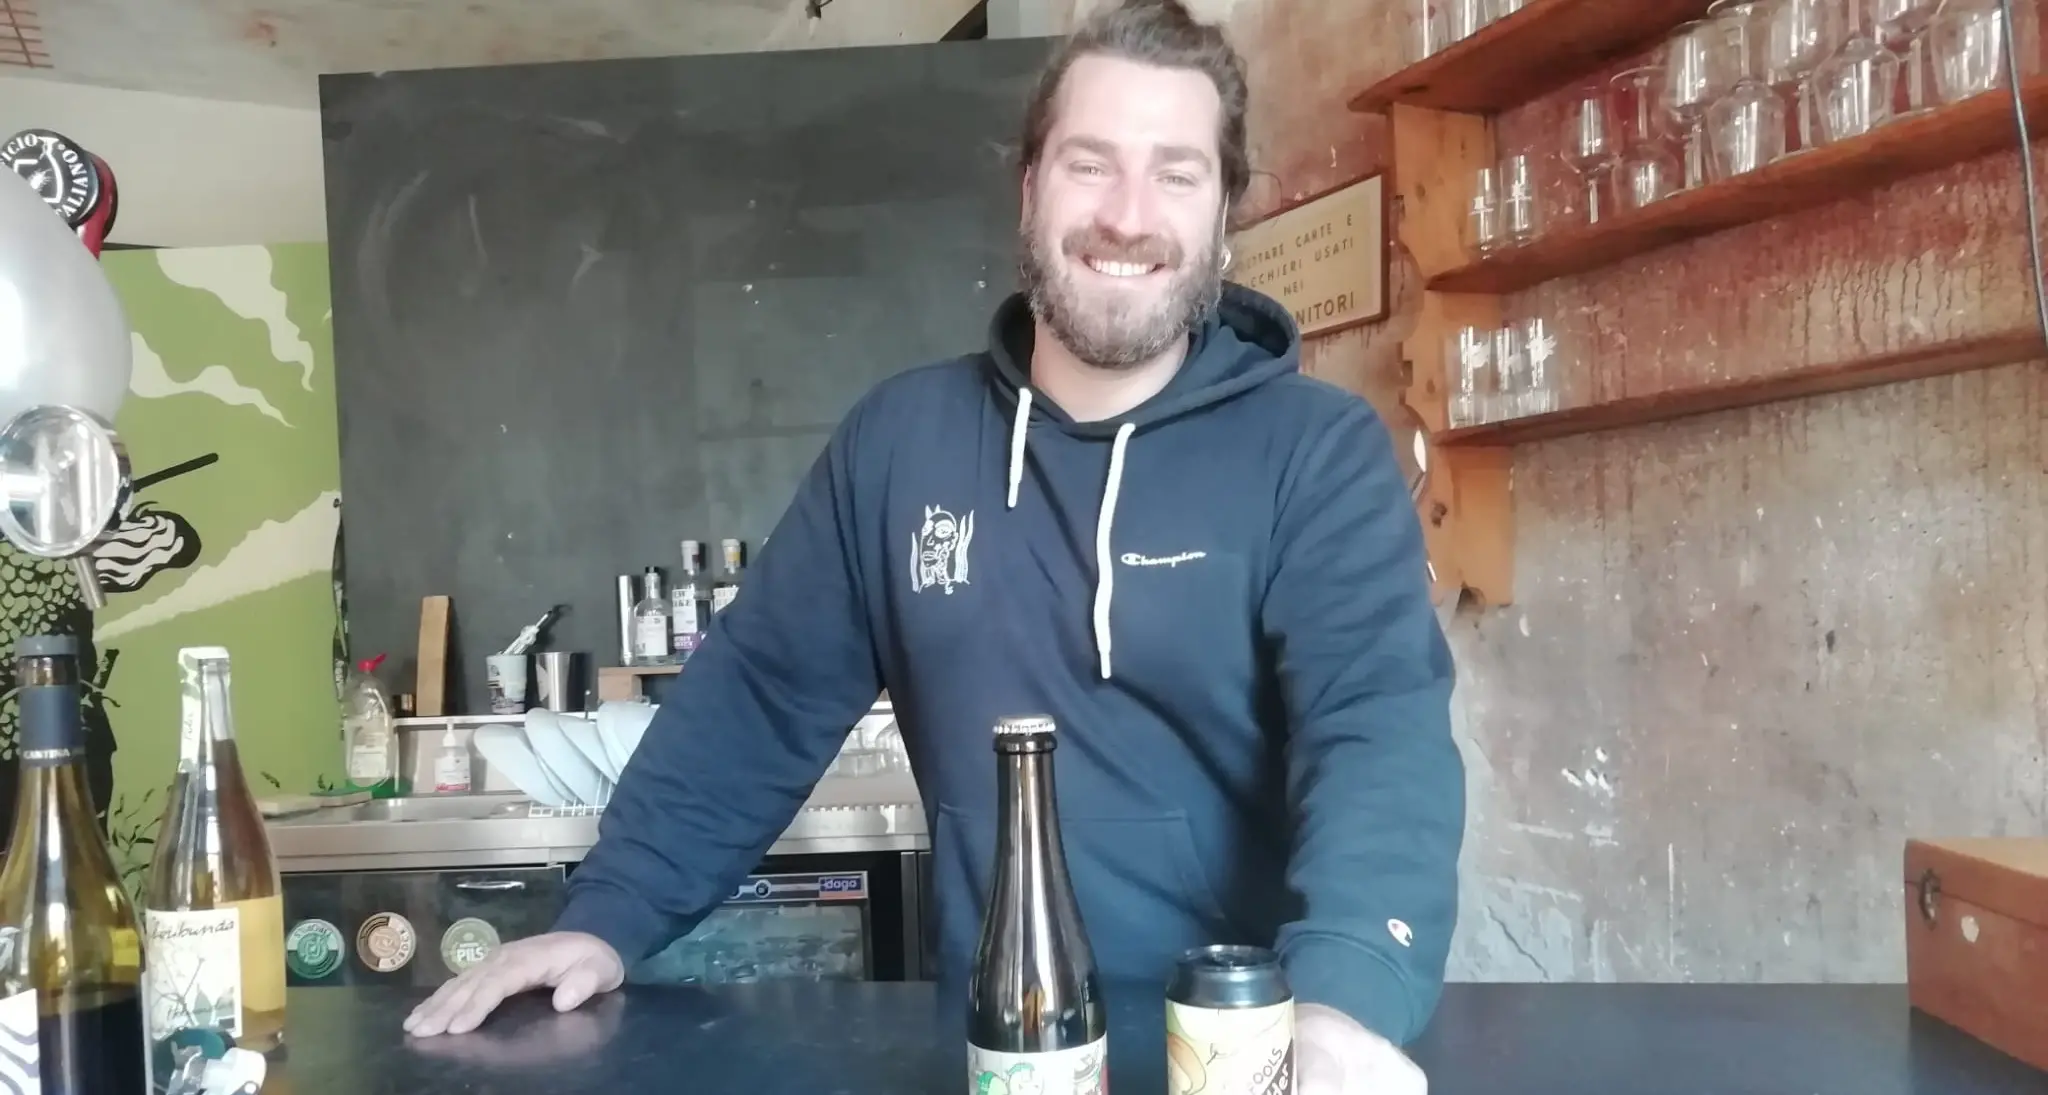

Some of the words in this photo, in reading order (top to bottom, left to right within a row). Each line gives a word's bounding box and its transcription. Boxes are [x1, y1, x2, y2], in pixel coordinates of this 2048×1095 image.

[0, 133, 38, 161] ICIO
[1296, 223, 1333, 248] CARTE
[1346, 213, 1353, 227] E
[1314, 238, 1354, 262] USATI
[1283, 280, 1304, 298] NEI
[1295, 291, 1355, 326] NITORI
[1121, 551, 1207, 568] Champion
[456, 946, 485, 962] PILS
